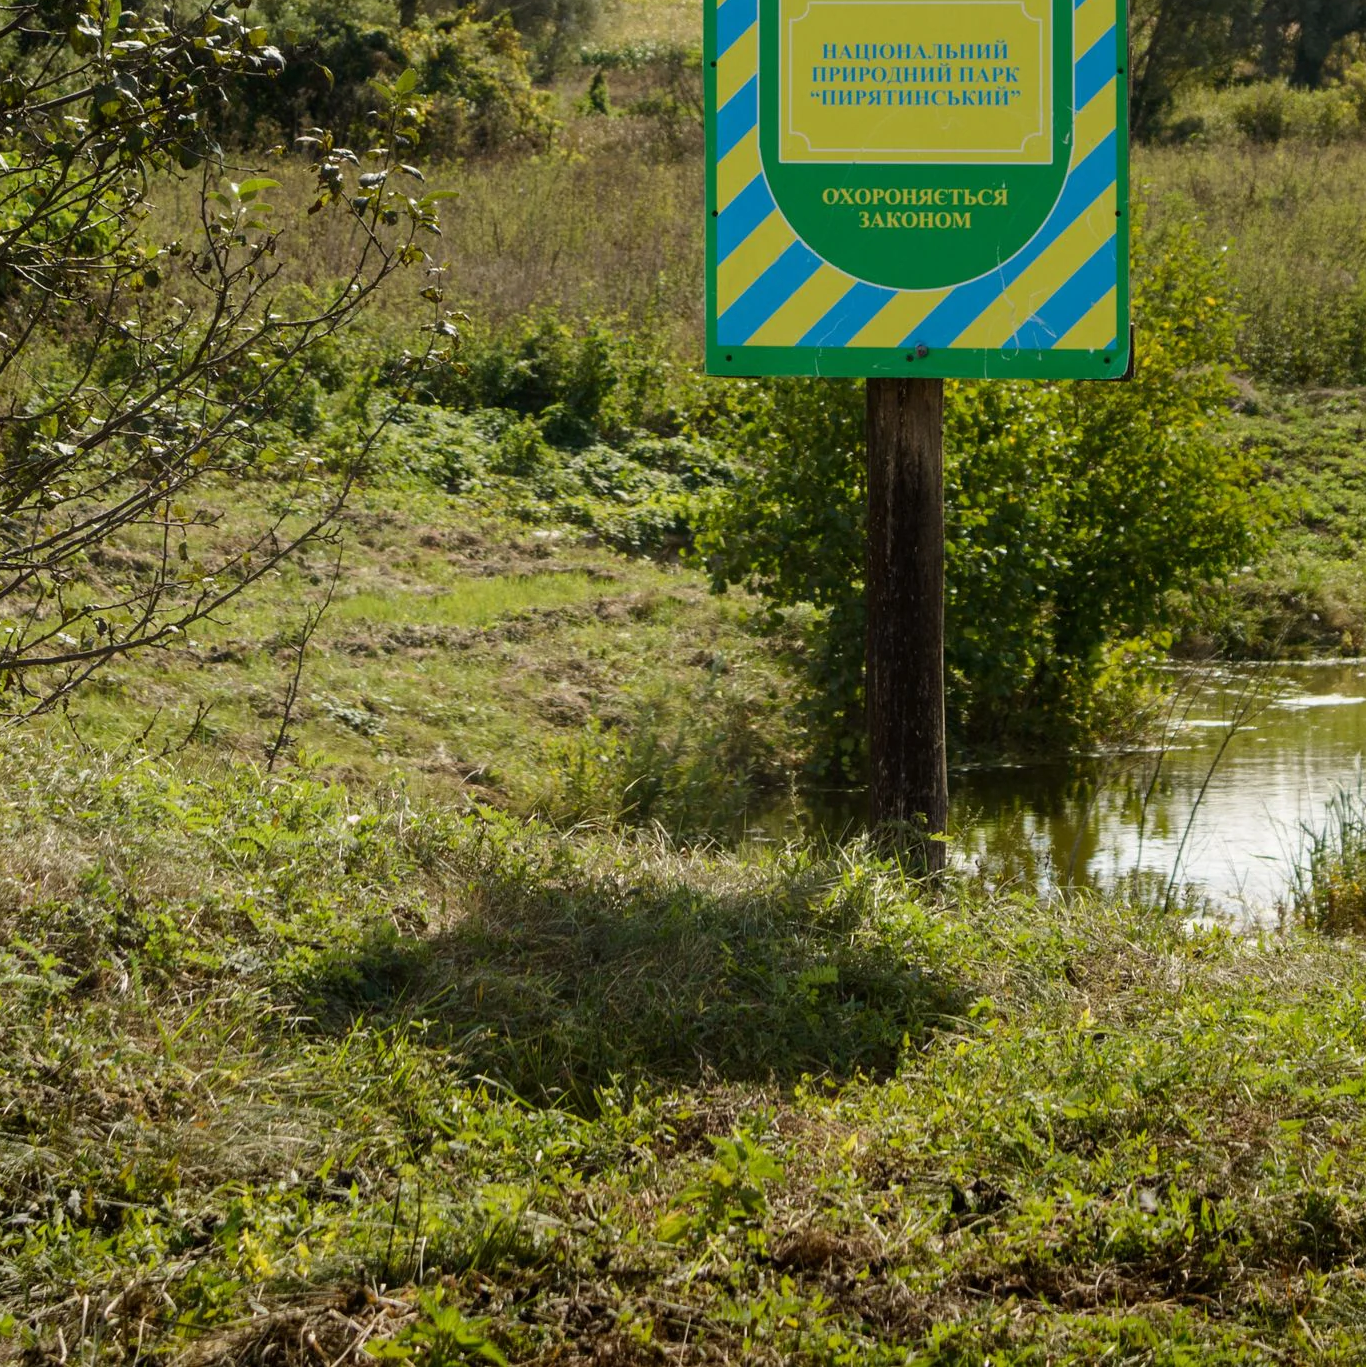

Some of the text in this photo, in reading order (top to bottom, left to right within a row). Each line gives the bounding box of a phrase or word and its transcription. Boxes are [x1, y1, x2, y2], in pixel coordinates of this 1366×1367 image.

[822, 39, 1008, 62] НАЦІОНАЛЬНИЙ
[812, 63, 1020, 85] ПРИРОДНИЙ ПАРК
[822, 188, 1009, 206] ОХОРОНЯЄТЬСЯ
[858, 211, 972, 229] ЗАКОНОМ
